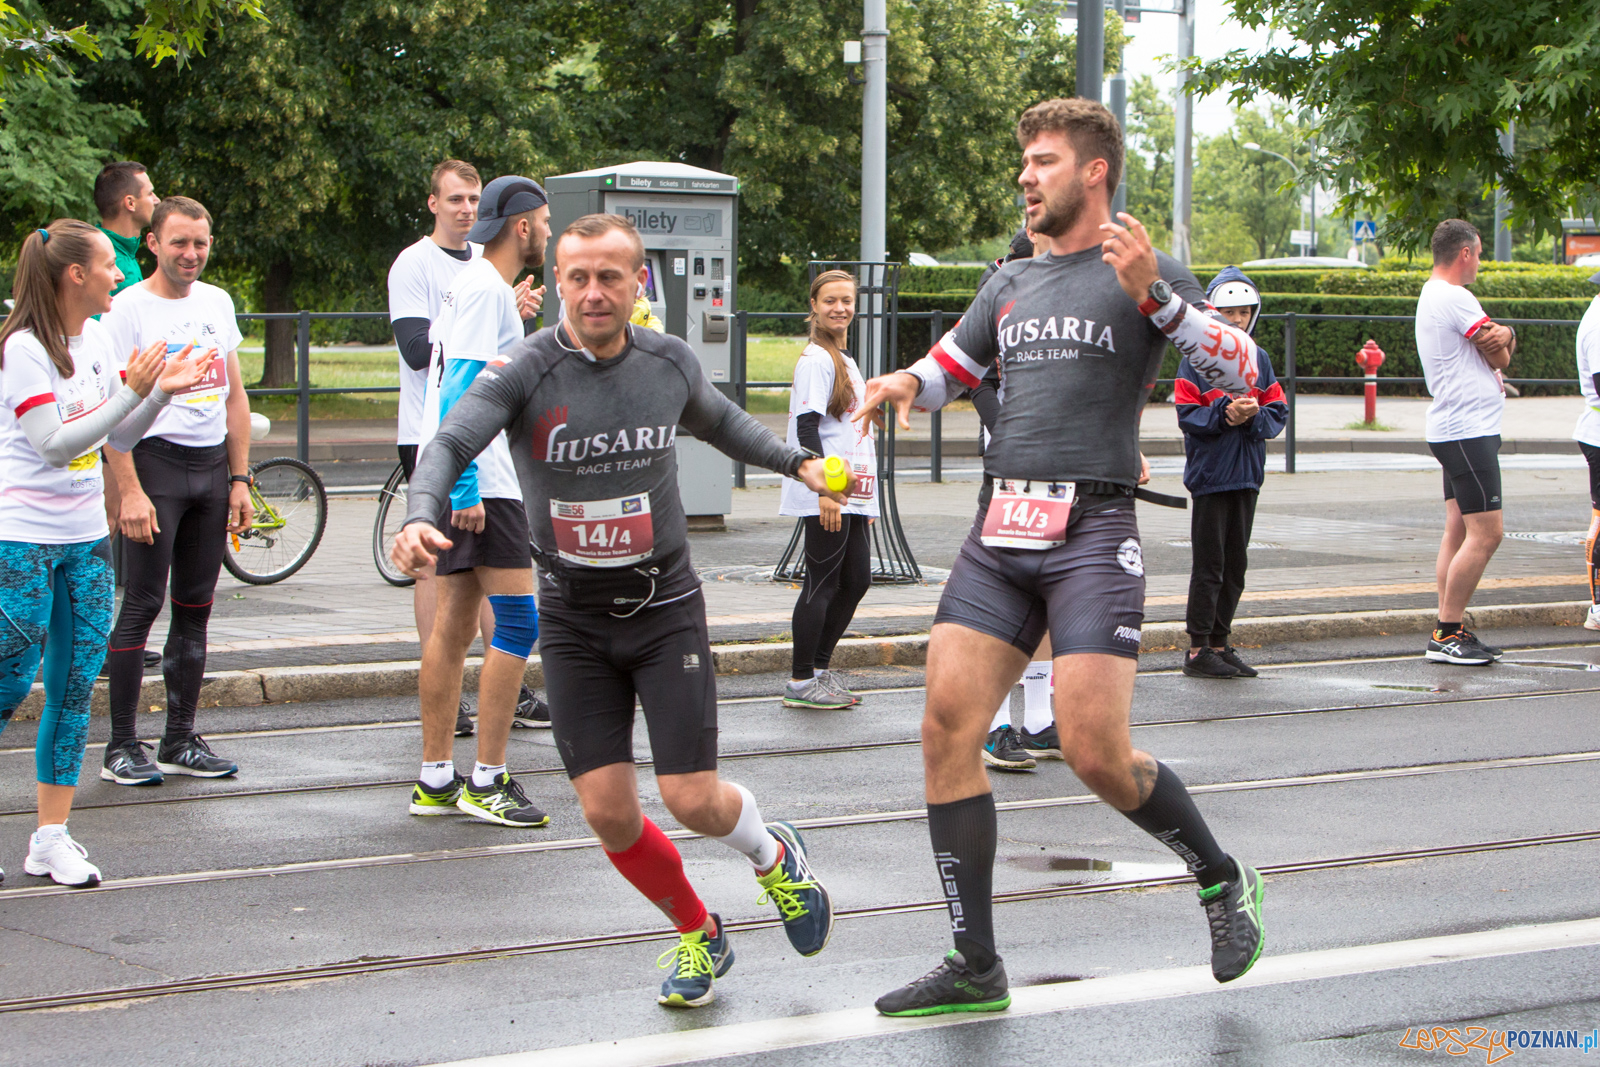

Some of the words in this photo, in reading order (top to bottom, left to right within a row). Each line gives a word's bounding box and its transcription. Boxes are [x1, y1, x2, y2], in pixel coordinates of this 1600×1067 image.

[630, 178, 652, 188] bilety
[659, 180, 679, 188] tickets
[691, 181, 720, 189] fahrkarten
[625, 209, 678, 233] bilety
[997, 313, 1116, 353] HUSARIA
[1016, 349, 1044, 362] RACE
[1046, 348, 1079, 360] TEAM
[545, 423, 676, 462] HUSARIA
[576, 462, 612, 475] RACE
[615, 457, 652, 471] TEAM
[572, 504, 585, 515] 56
[1002, 501, 1049, 529] 14/3
[571, 523, 632, 548] 14/4
